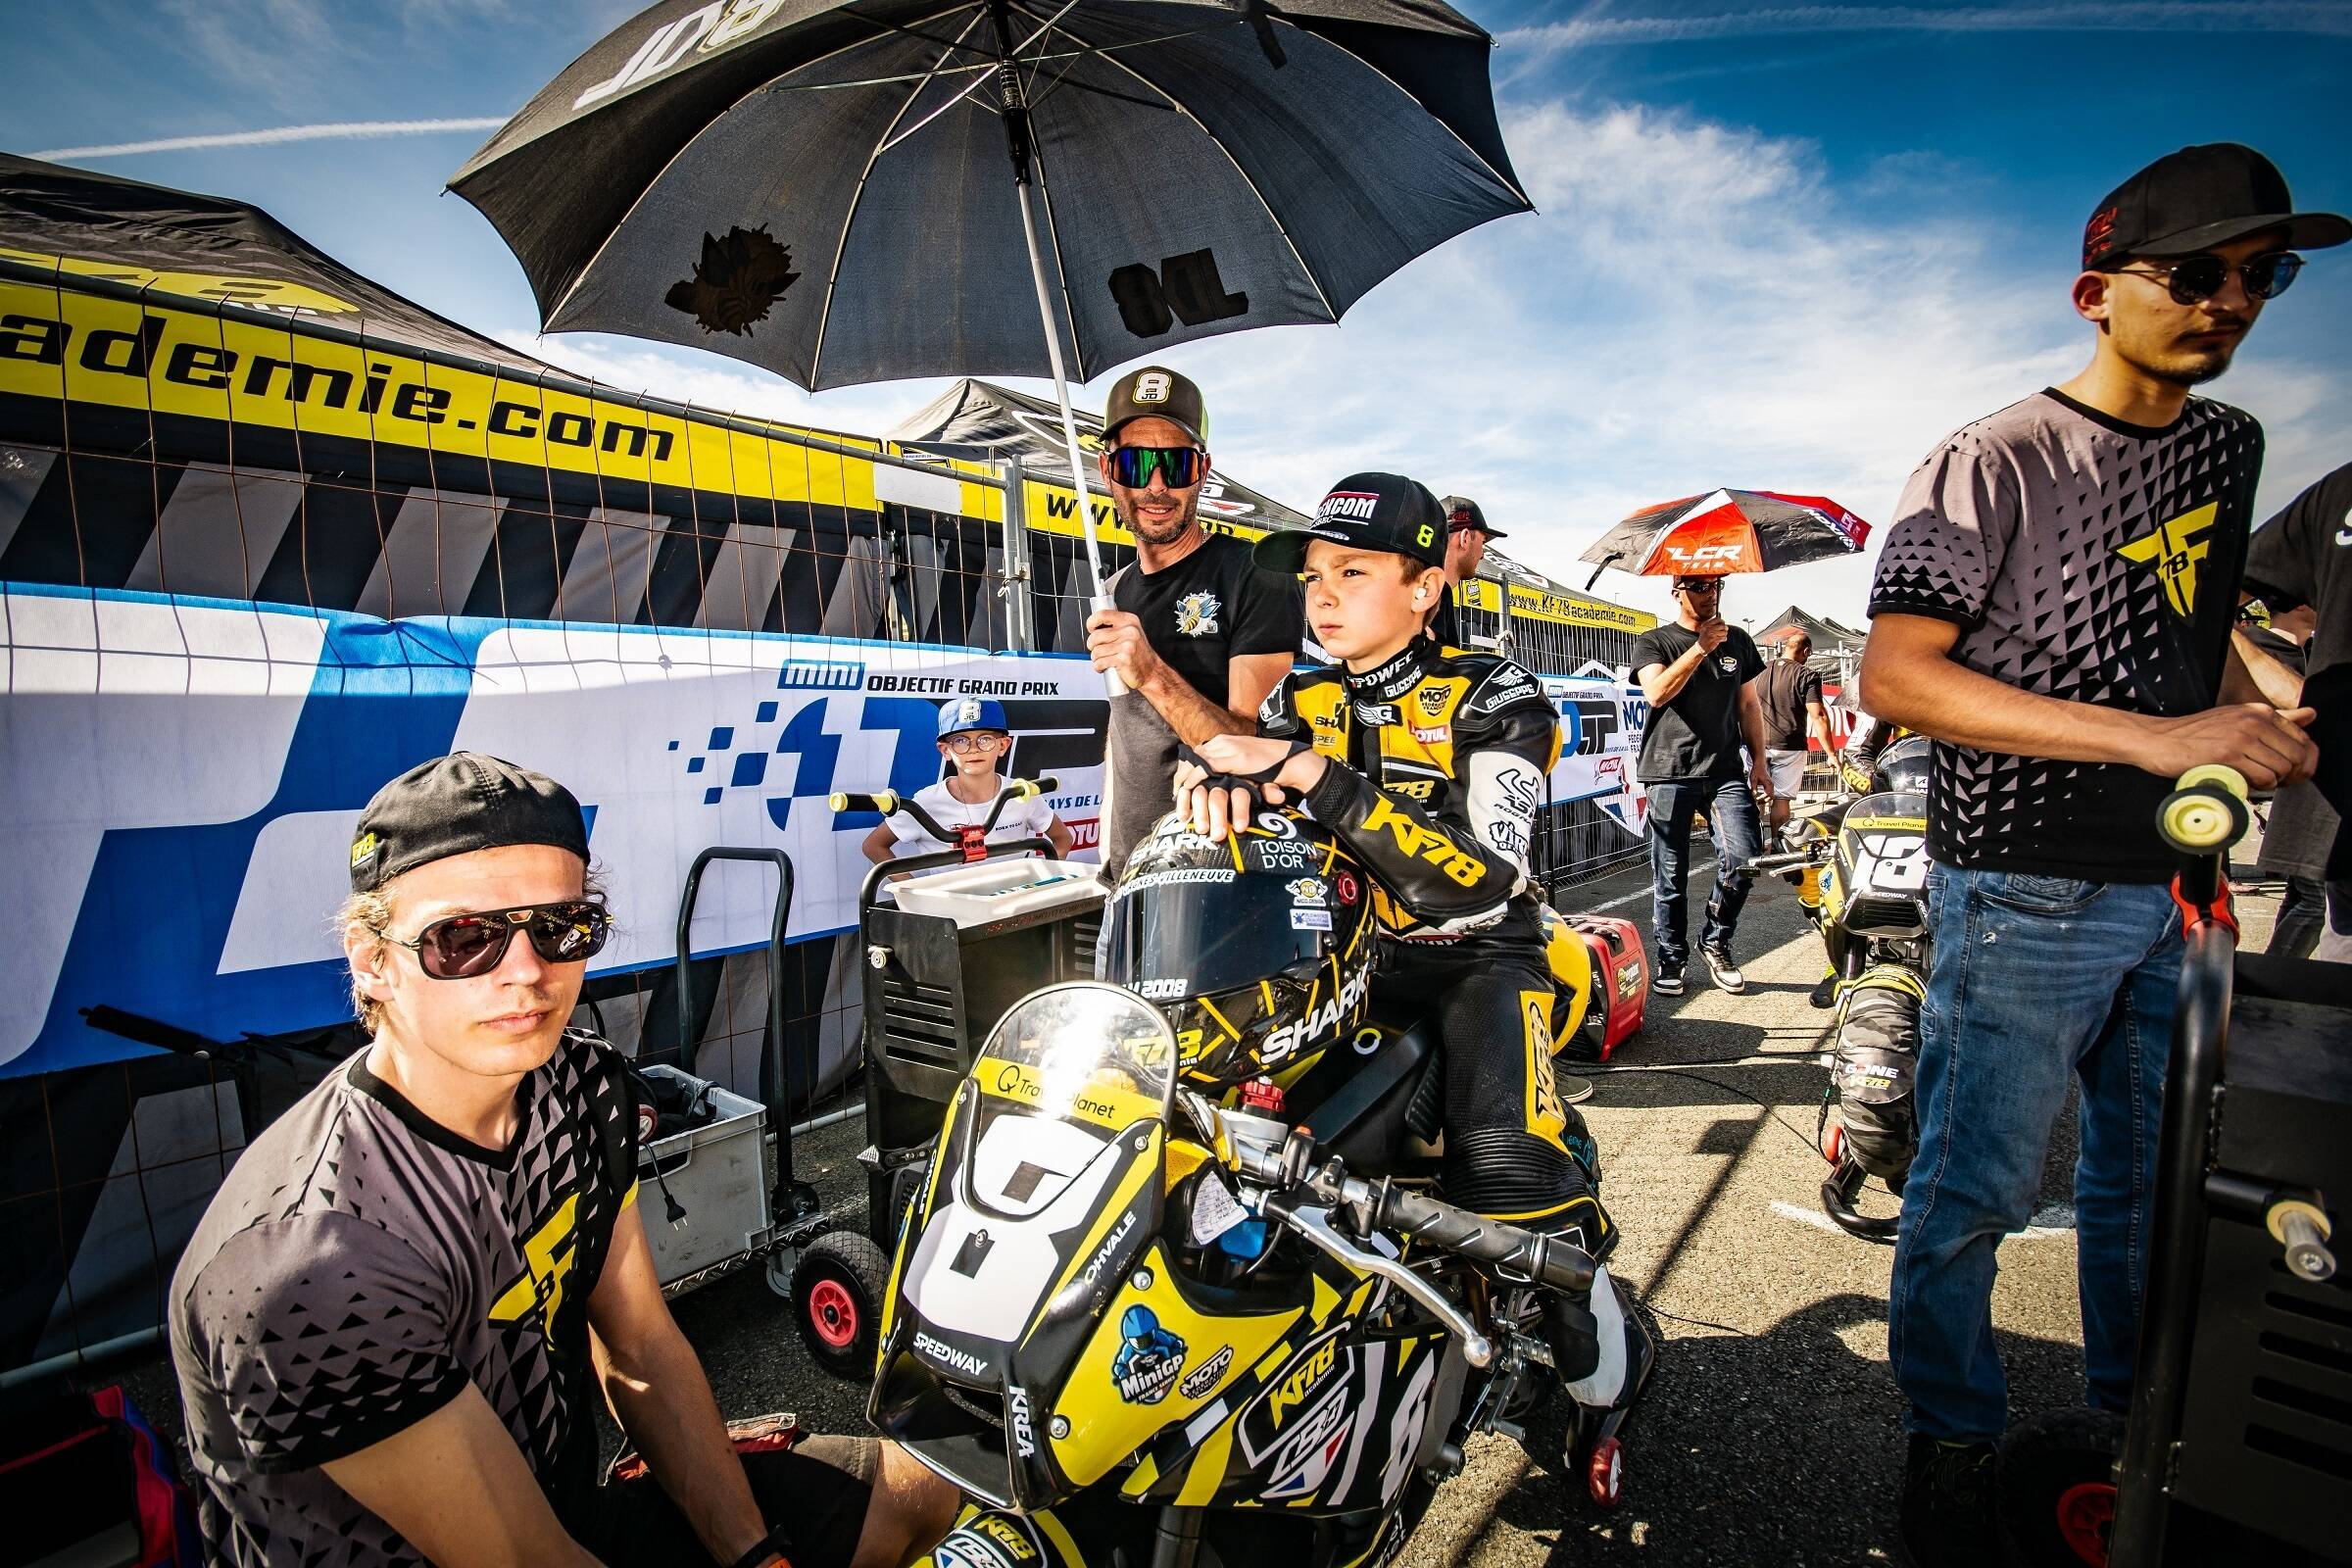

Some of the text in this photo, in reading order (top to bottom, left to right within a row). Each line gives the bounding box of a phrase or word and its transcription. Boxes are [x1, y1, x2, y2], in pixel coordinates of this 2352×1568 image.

[1133, 370, 1172, 404] 8
[1417, 524, 1434, 548] 8
[1667, 545, 1743, 561] LCR
[867, 675, 1059, 696] OBJECTIF GRAND PRIX
[1486, 683, 1535, 710] GIUSEPPE
[1045, 796, 1072, 809] AYS
[1075, 796, 1091, 808] DE
[1130, 833, 1218, 866] SHARK
[1251, 839, 1317, 857] TOISON
[1360, 792, 1487, 887] KF78
[1262, 854, 1304, 869] D'OR
[1141, 979, 1188, 999] 2008
[1259, 962, 1368, 1065] SHARK
[1073, 1093, 1115, 1119] lanet
[1084, 1210, 1137, 1285] OHVALE
[913, 1331, 988, 1376] SPEEDWAY
[1120, 1354, 1184, 1399] MiniGP
[1181, 1348, 1233, 1396] MOTO
[1268, 1336, 1337, 1431] KF78
[1008, 1385, 1036, 1457] KREA
